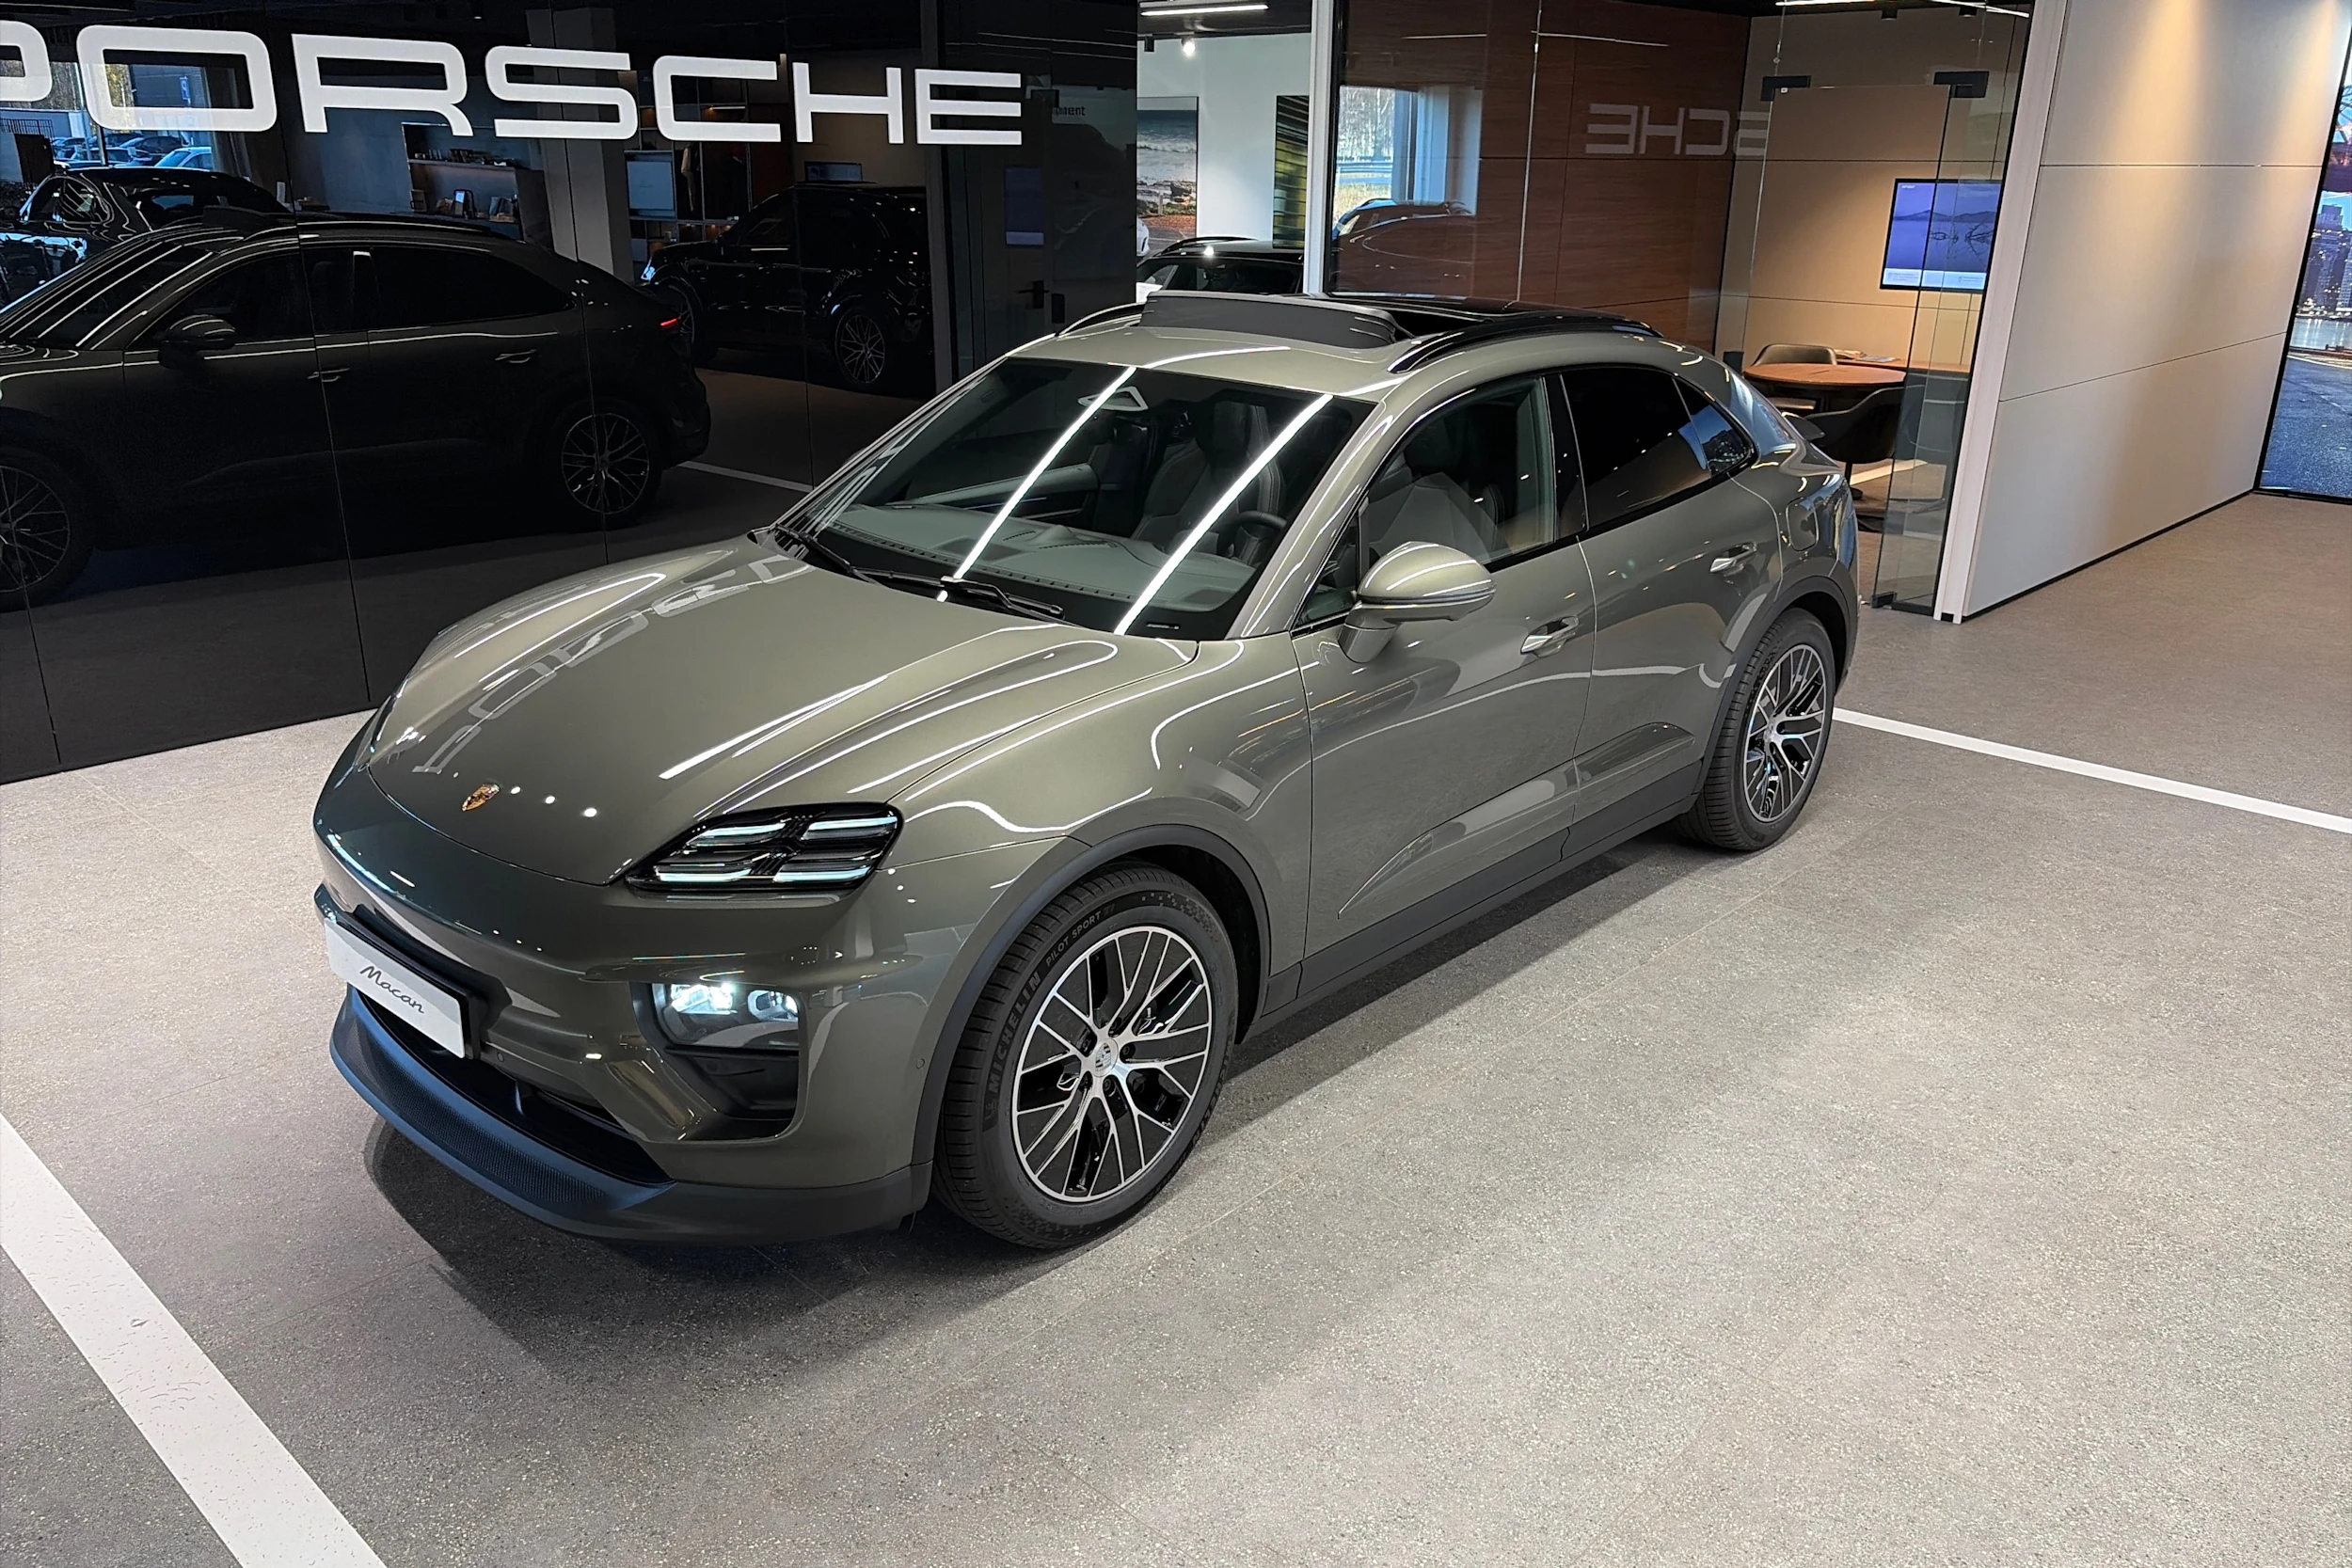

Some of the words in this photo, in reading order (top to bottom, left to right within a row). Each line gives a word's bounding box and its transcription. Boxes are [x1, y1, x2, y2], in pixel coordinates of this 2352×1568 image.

[0, 21, 1022, 145] ORSCHE
[359, 965, 424, 1014] Macan
[987, 969, 1042, 1094] MICHELIN
[1044, 935, 1070, 967] PILOT
[1071, 909, 1101, 939] SPORT
